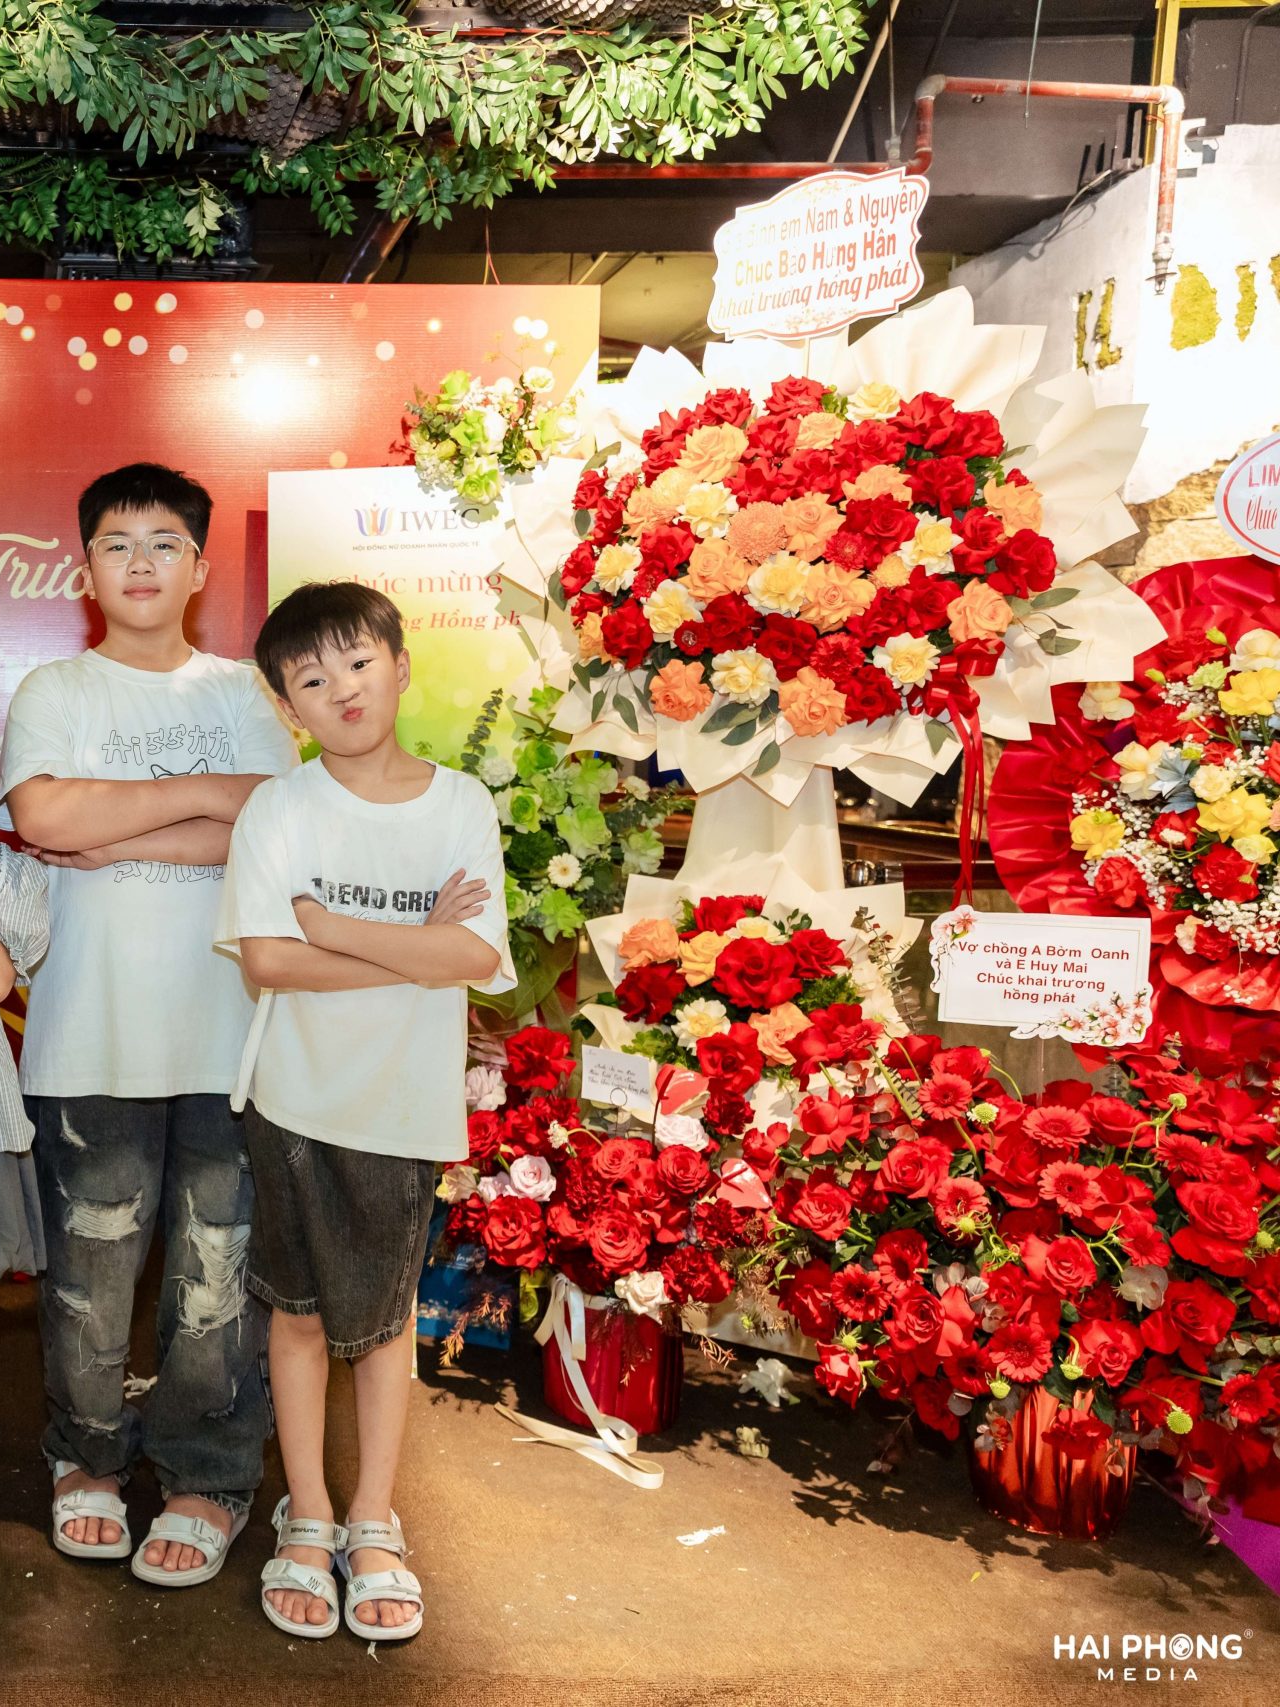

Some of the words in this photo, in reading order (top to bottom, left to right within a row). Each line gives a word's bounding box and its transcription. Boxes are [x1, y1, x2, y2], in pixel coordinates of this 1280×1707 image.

[805, 207, 838, 235] Nam
[843, 198, 854, 227] &
[862, 228, 897, 261] Hân
[865, 259, 910, 299] phát
[400, 508, 480, 532] IWEC
[418, 569, 502, 596] mừng
[429, 609, 487, 631] Hồng
[958, 941, 979, 955] Vợ
[983, 941, 1028, 958] chồng
[1031, 946, 1041, 956] A
[1046, 946, 1082, 958] Bờm
[1091, 948, 1130, 960] Oanh
[996, 958, 1012, 970] và
[1016, 960, 1026, 970] E
[1030, 960, 1058, 974] Huy
[1063, 962, 1088, 973] Mai
[977, 972, 1014, 985] Chúc
[1018, 976, 1047, 987] khai
[1051, 978, 1105, 992] trương
[1003, 987, 1039, 1003] hồng
[1043, 990, 1076, 1005] phát
